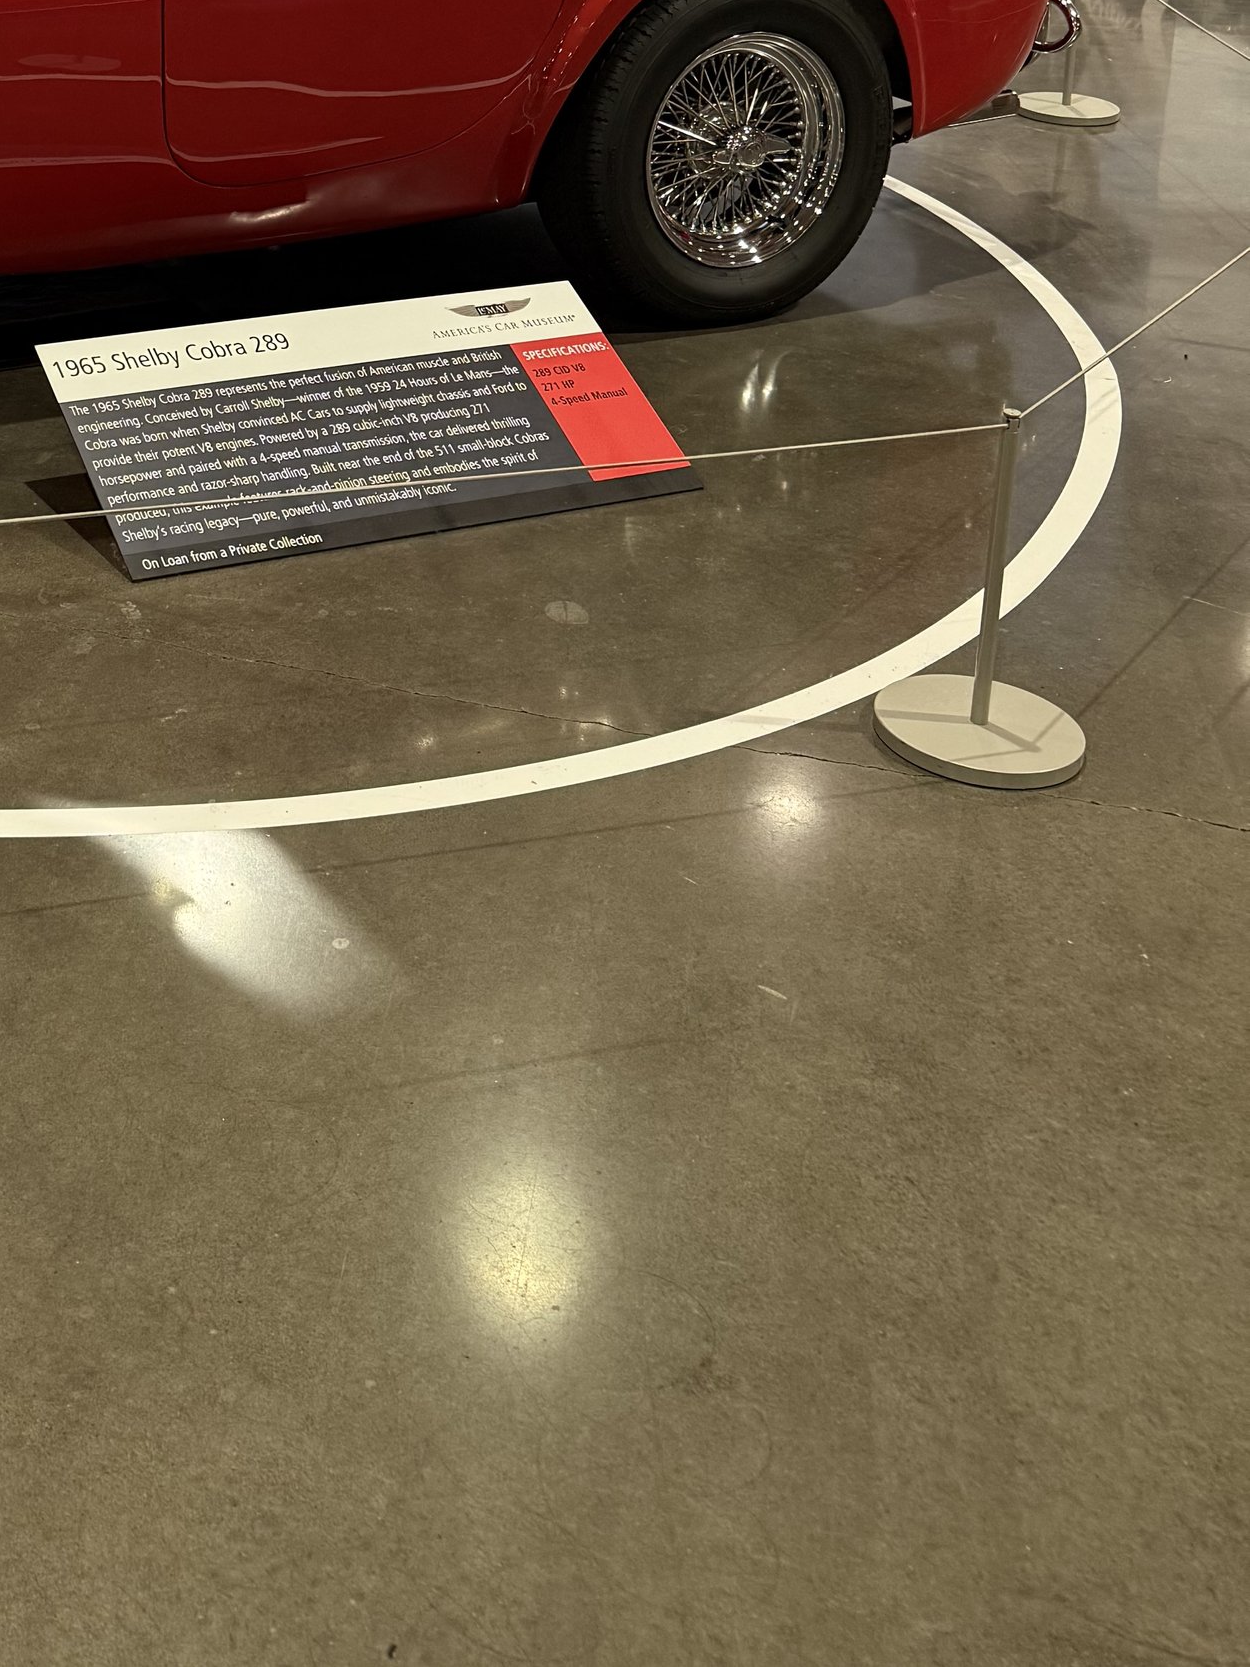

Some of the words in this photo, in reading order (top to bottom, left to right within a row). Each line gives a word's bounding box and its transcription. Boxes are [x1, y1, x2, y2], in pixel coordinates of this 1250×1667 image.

[432, 324, 492, 338] AMERICA'S
[494, 322, 519, 331] CAR
[52, 355, 106, 378] 1965
[111, 347, 179, 370] Shelby
[185, 340, 247, 360] Cobra
[249, 332, 289, 352] 289
[522, 341, 609, 361] SPECIFICATIONS:
[532, 367, 551, 377] 289
[552, 365, 570, 374] CID
[570, 362, 586, 372] V8
[68, 405, 89, 415] The
[91, 400, 120, 413] 1965
[121, 395, 156, 409] Shelby
[158, 392, 190, 403] Cobra
[191, 387, 213, 399] 289
[215, 382, 268, 397] represents
[268, 378, 286, 389] the
[288, 373, 323, 389] perfect
[323, 370, 355, 381] fusion
[356, 366, 367, 377] of
[369, 362, 415, 376] American
[415, 356, 450, 369] muscle
[451, 353, 470, 365] and
[469, 349, 502, 362] British
[540, 381, 560, 391] 271
[561, 379, 574, 388] HP
[551, 392, 590, 406] 4-Speed
[590, 386, 628, 400] Manual
[121, 525, 167, 542] Shelby's
[169, 521, 204, 534] racing
[280, 499, 331, 520] powerful,
[331, 496, 352, 509] and
[353, 486, 422, 506] unmistakably
[424, 481, 457, 496] iconic.
[141, 558, 159, 569] On
[160, 555, 189, 567] Loan
[189, 550, 218, 562] from
[219, 549, 227, 557] a
[228, 542, 267, 556] Private
[268, 533, 323, 549] Collection
